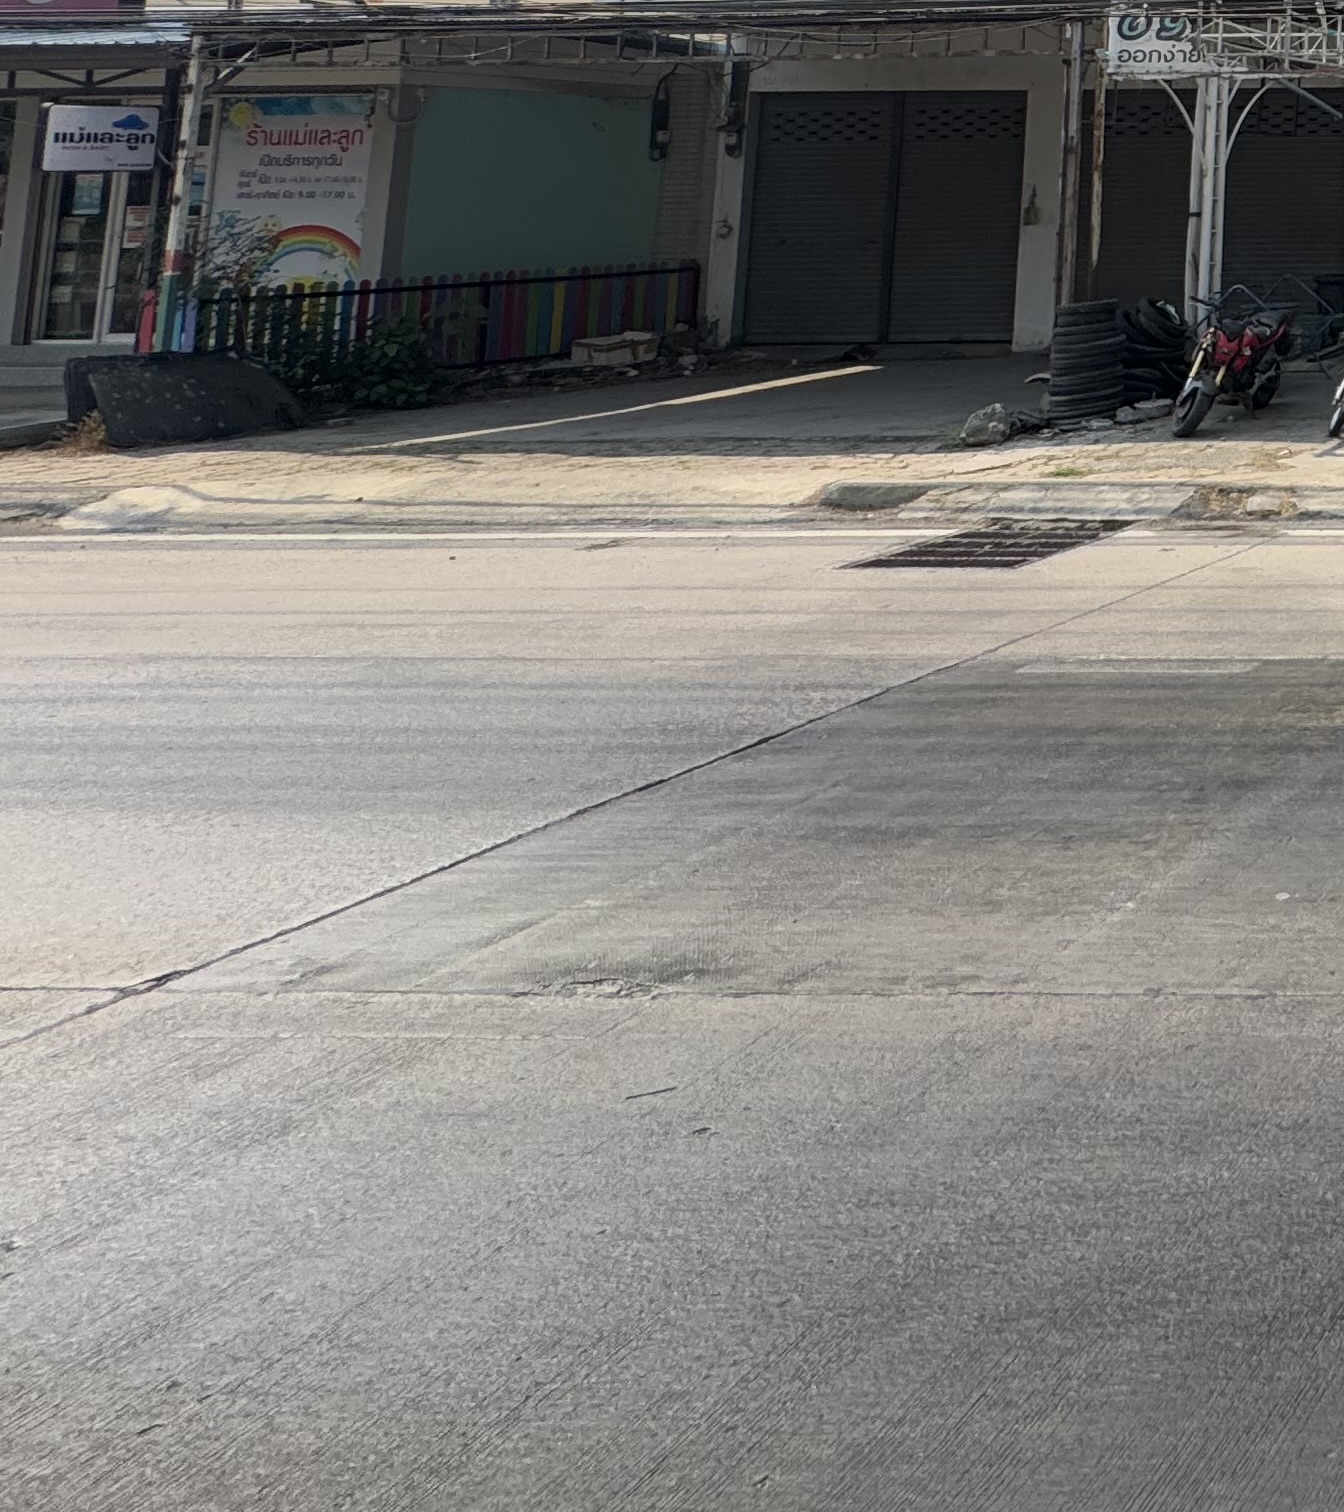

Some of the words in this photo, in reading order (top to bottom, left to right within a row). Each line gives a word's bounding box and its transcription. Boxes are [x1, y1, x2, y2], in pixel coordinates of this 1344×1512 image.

[246, 122, 364, 153] ร้านแม่และลูก
